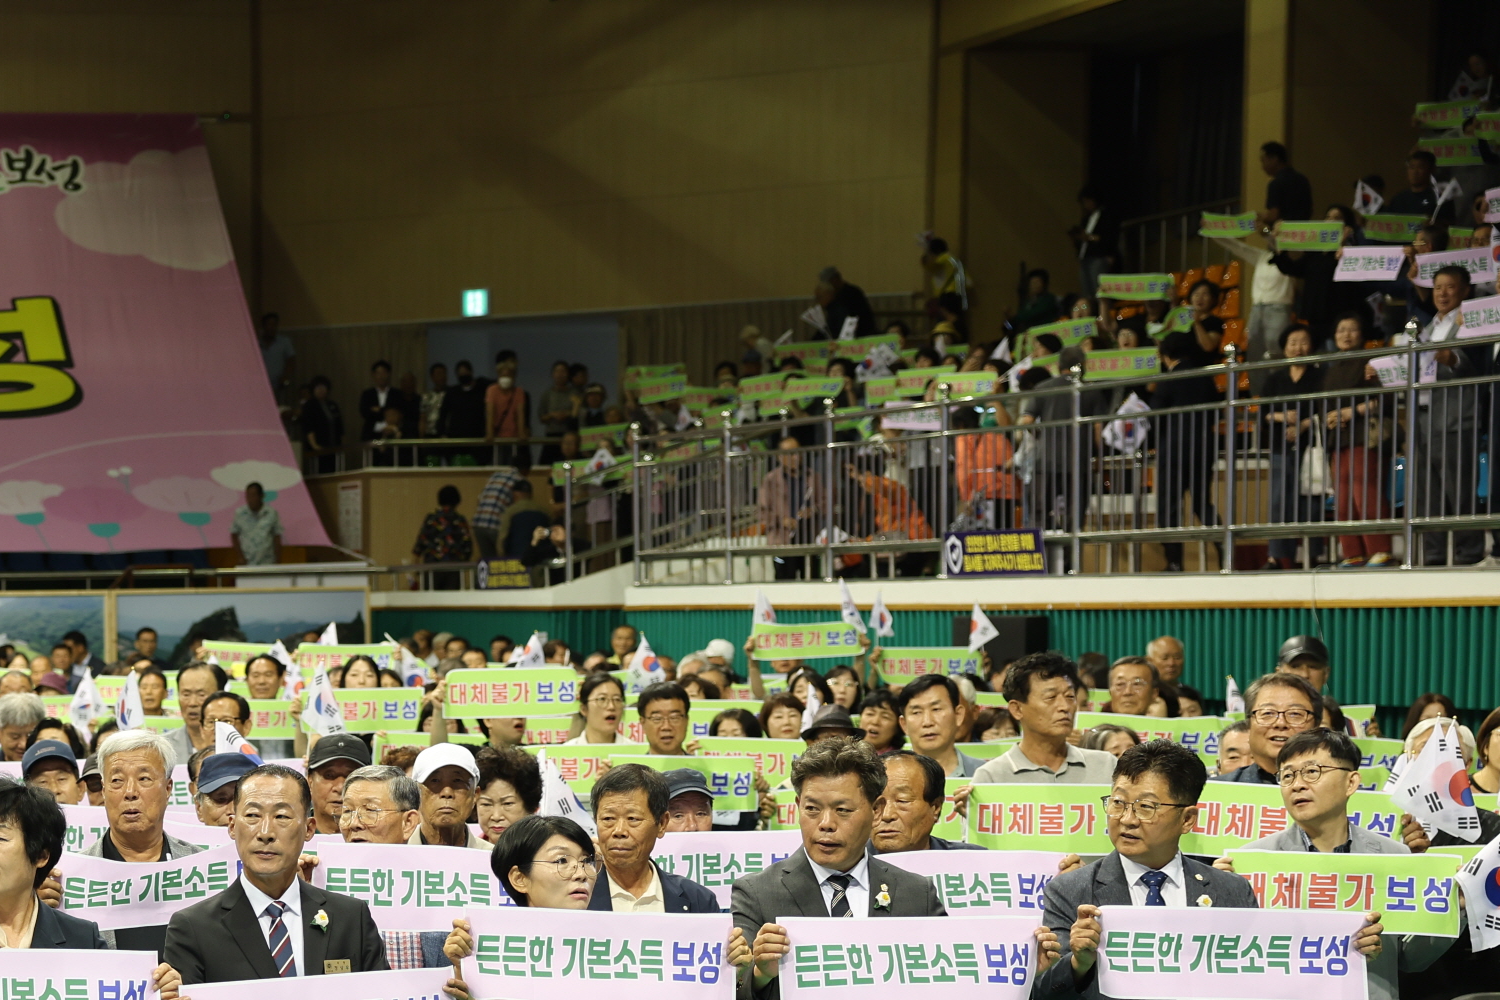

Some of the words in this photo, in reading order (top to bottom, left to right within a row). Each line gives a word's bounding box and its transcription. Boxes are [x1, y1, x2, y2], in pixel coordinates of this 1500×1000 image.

[3, 146, 84, 194] 보성
[756, 632, 822, 649] 대체불가
[826, 630, 858, 646] 보성
[948, 658, 978, 675] 보성
[450, 682, 530, 705] 대체불가
[537, 681, 575, 703] 보성
[252, 711, 288, 728] 불가
[342, 701, 378, 723] 불가
[383, 700, 418, 720] 보성
[711, 772, 752, 797] 보성
[977, 803, 1096, 836] 대체불가
[1193, 801, 1288, 839] 대체불
[63, 877, 133, 909] 든든한
[139, 860, 229, 902] 기본소득
[681, 852, 764, 886] 기본소득
[325, 867, 395, 908] 든든한
[401, 868, 491, 908] 기본소득
[1385, 875, 1452, 914] 보성
[476, 934, 553, 979] 든든한
[562, 937, 664, 981] 기본소득
[672, 941, 722, 985] 보성
[795, 944, 874, 988] 든든한
[878, 943, 980, 984] 기본소득
[984, 943, 1030, 986] 보성
[1105, 931, 1182, 974] 든든한
[1189, 934, 1293, 976] 기본소득
[1299, 935, 1351, 976] 보성
